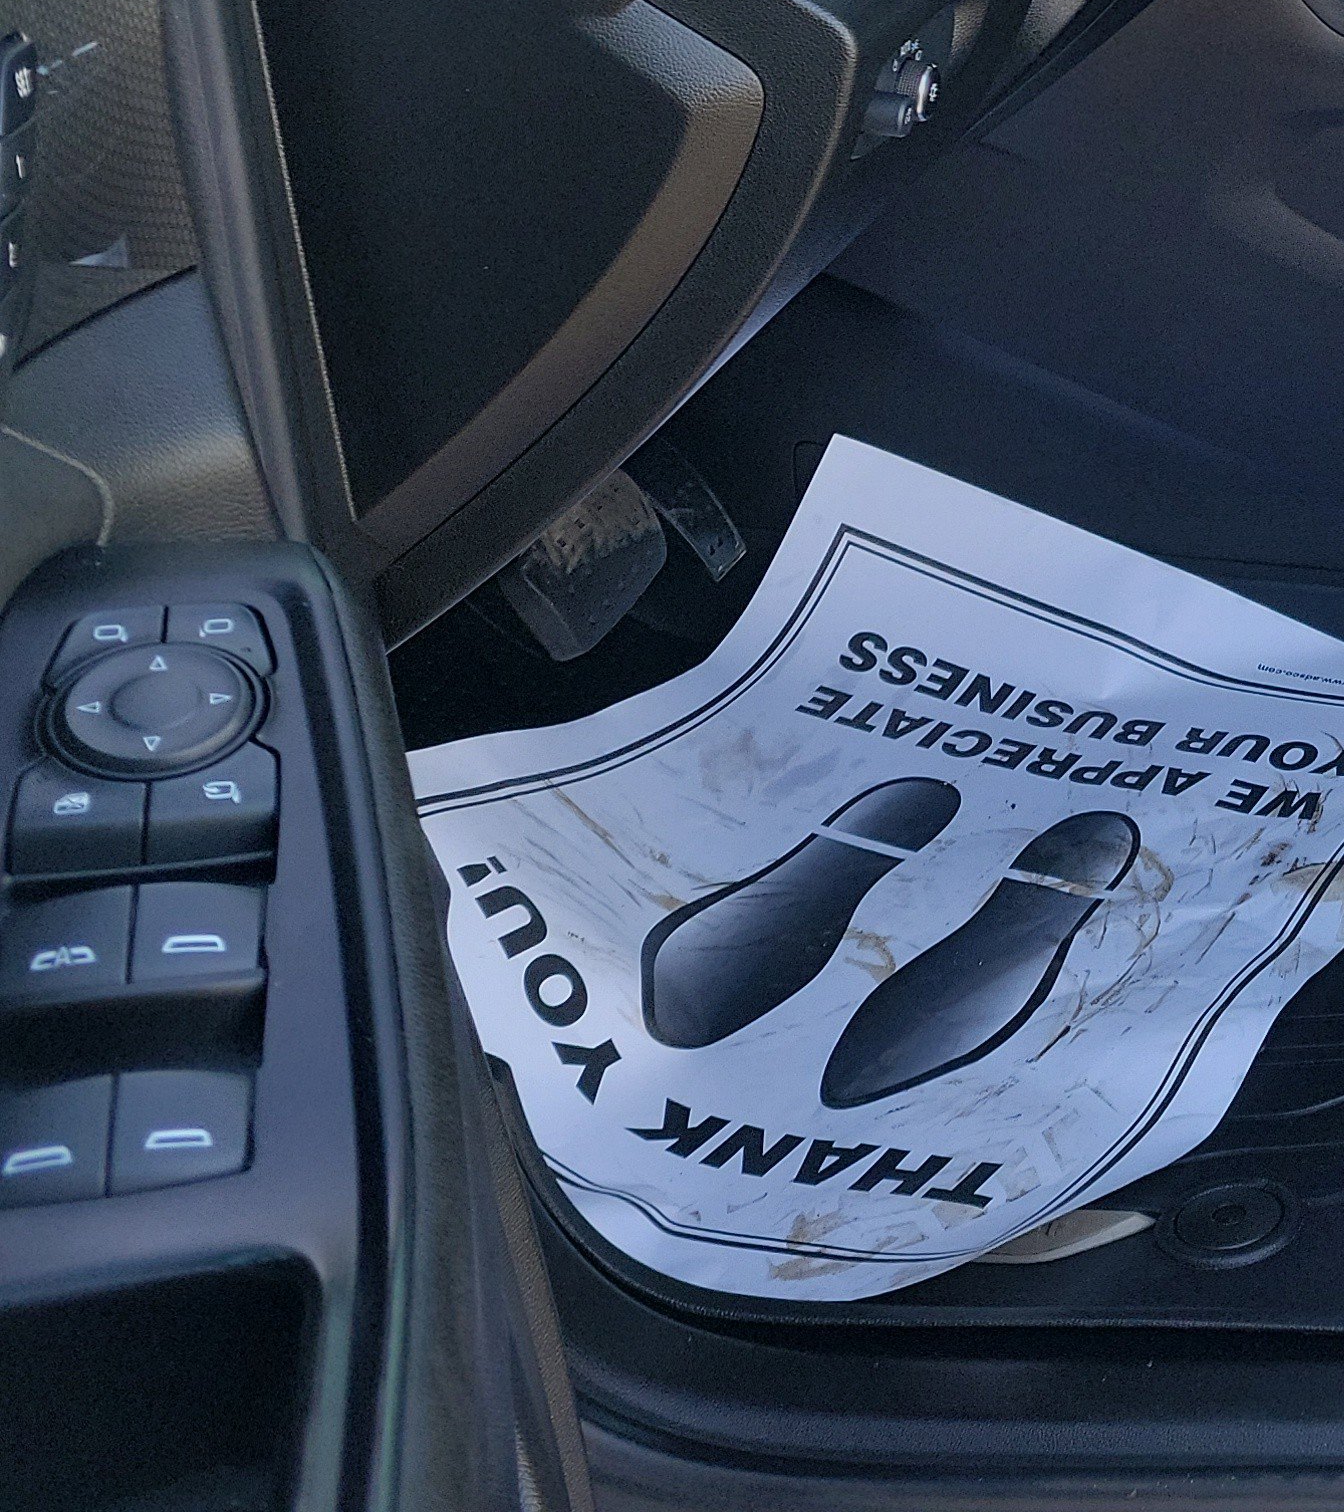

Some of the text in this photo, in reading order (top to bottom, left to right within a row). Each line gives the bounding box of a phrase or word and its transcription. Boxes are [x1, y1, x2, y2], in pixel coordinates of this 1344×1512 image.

[797, 685, 1321, 821] WE APPRECIATE
[838, 631, 1168, 748] BUSINESS
[459, 855, 1004, 1210] THANK YOU!
